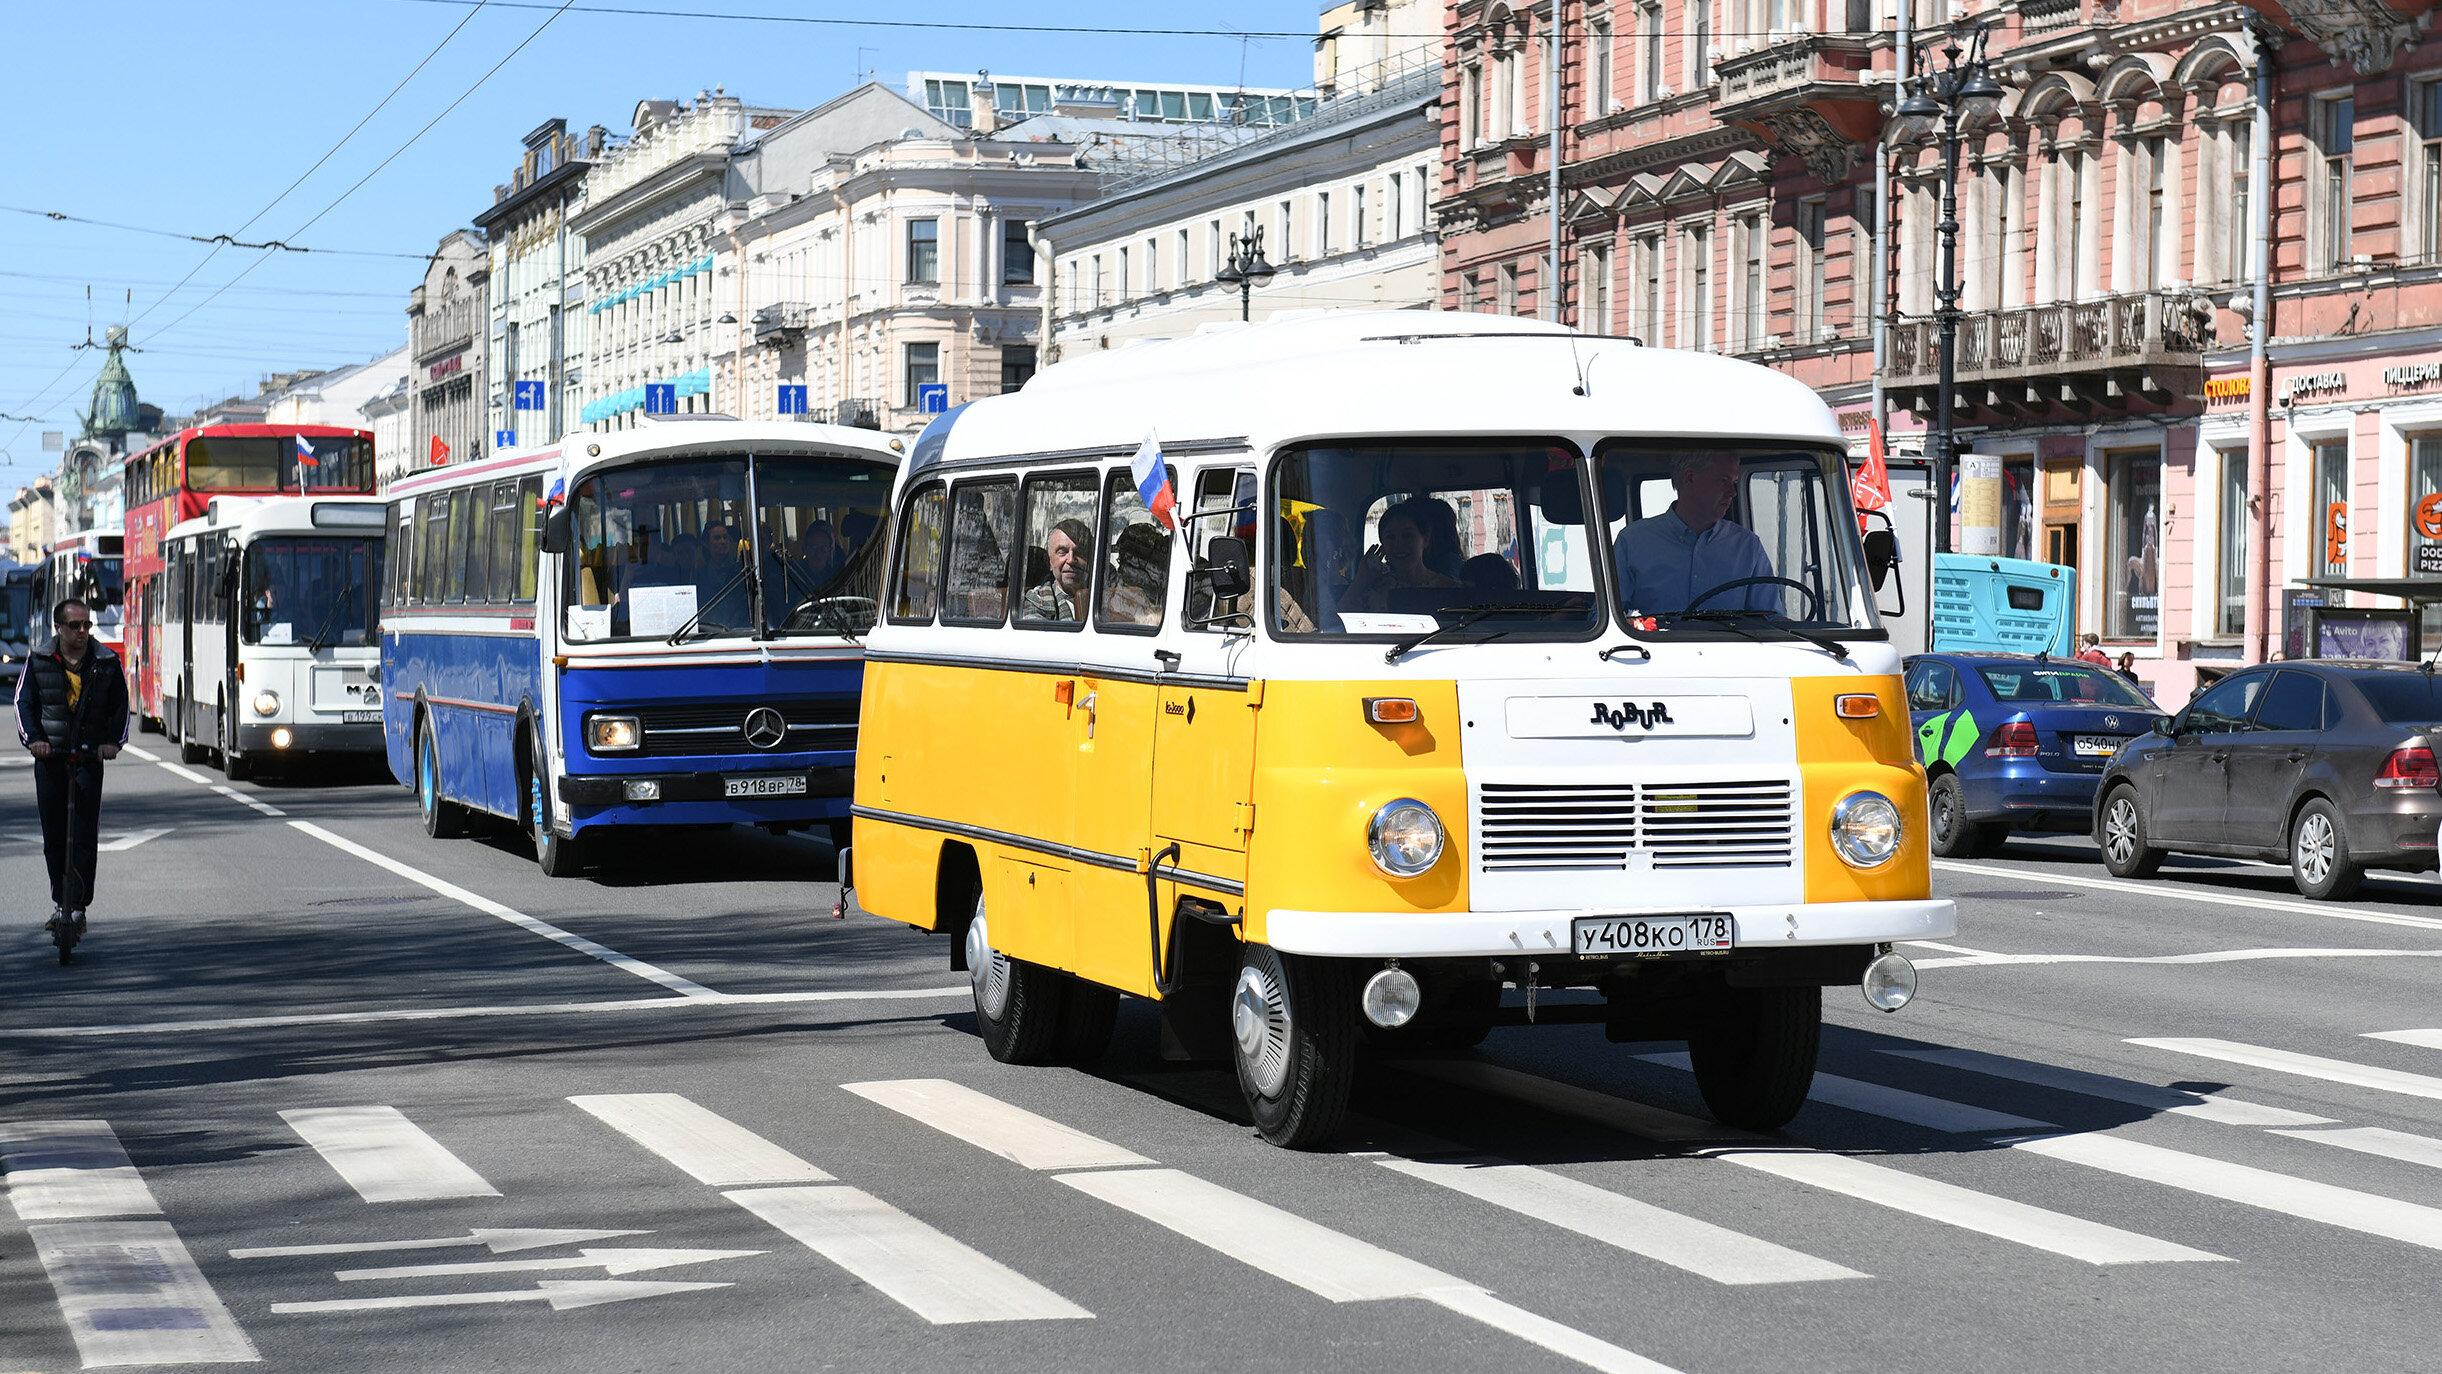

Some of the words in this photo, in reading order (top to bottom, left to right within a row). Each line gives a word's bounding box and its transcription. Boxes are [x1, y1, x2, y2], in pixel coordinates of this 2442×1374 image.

[2292, 372, 2343, 395] ДОСТАВКА
[2383, 362, 2440, 385] ПИЦЦЕРИЯ
[2334, 626, 2358, 636] Avito
[1590, 702, 1674, 730] ROBUR
[730, 779, 785, 794] В918ВР
[788, 777, 802, 788] 78
[1583, 921, 1684, 950] У408КО
[1688, 917, 1726, 939] 178
[1696, 938, 1716, 947] RUS
